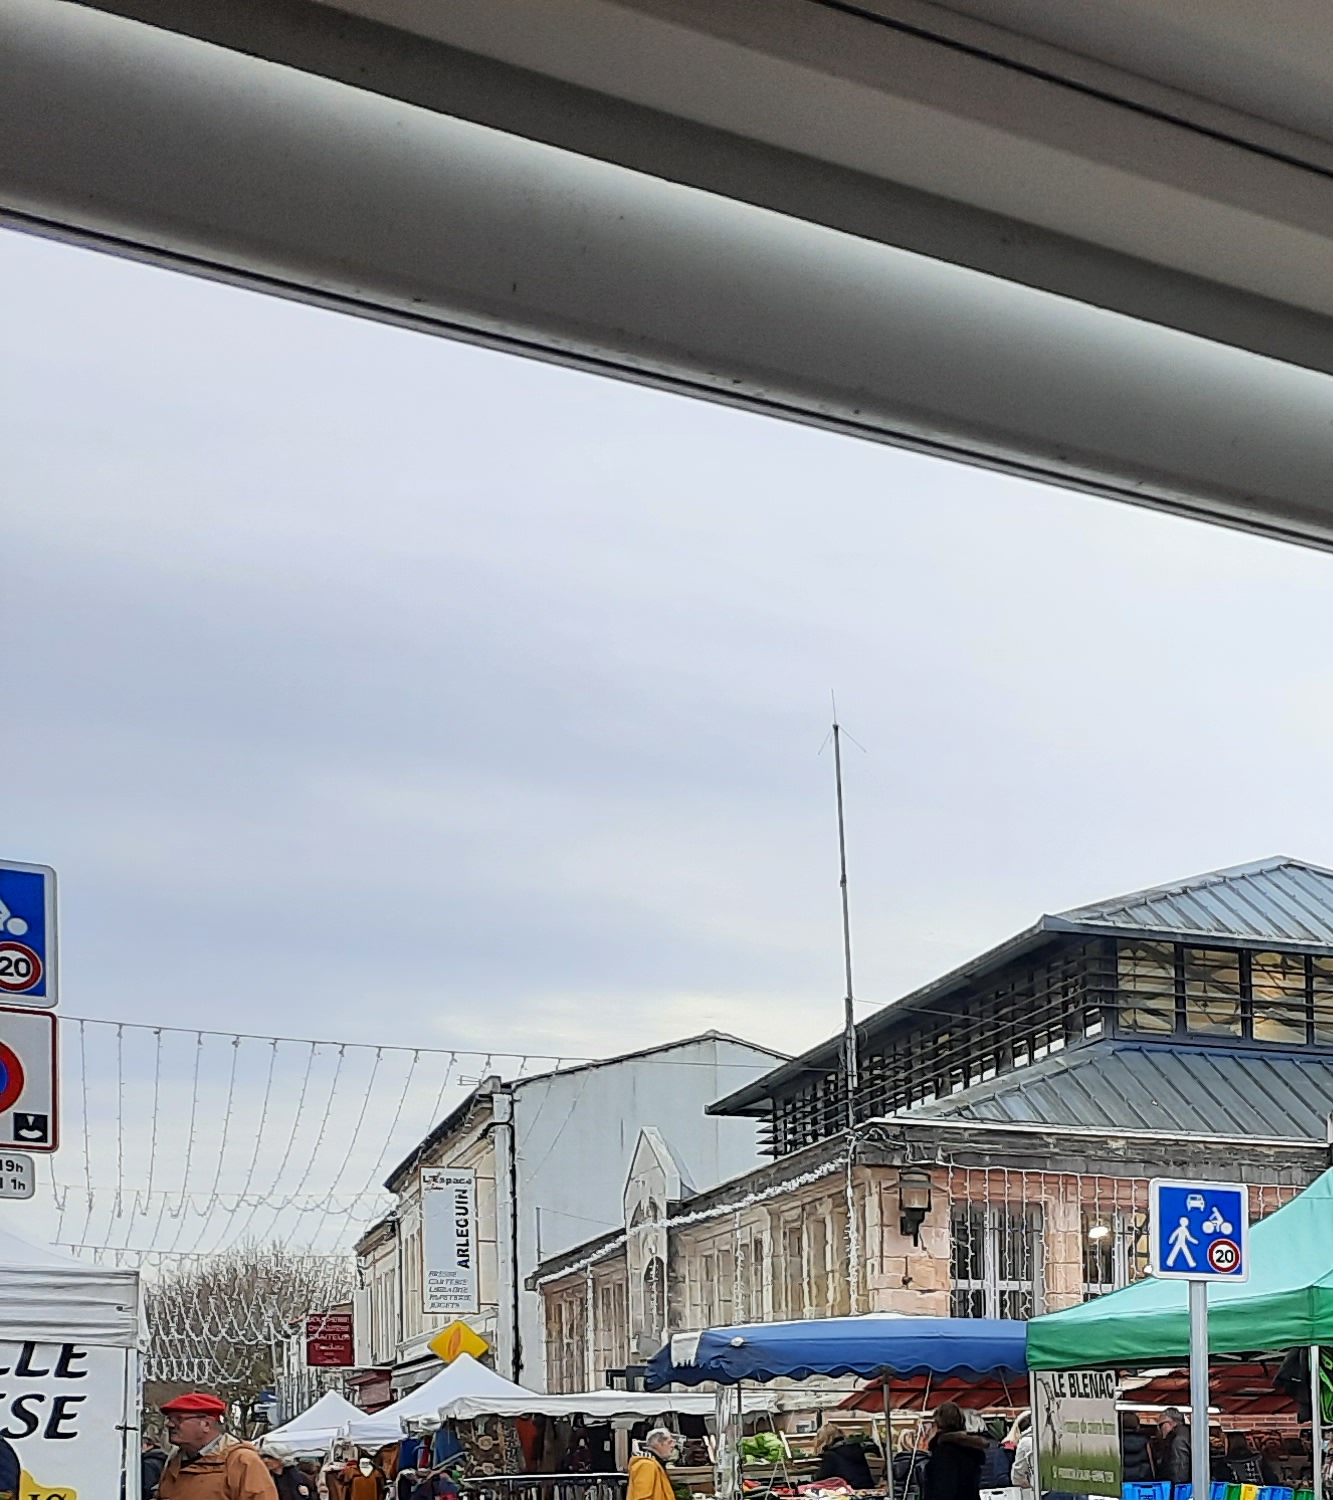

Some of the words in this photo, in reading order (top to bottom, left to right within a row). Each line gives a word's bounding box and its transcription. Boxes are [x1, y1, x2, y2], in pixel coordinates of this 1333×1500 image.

[0, 956, 31, 977] 20
[1215, 1249, 1234, 1263] 20
[0, 1341, 89, 1379] LE
[1052, 1373, 1067, 1398] LE
[1068, 1373, 1115, 1399] BLENAC
[0, 1393, 88, 1440] SE
